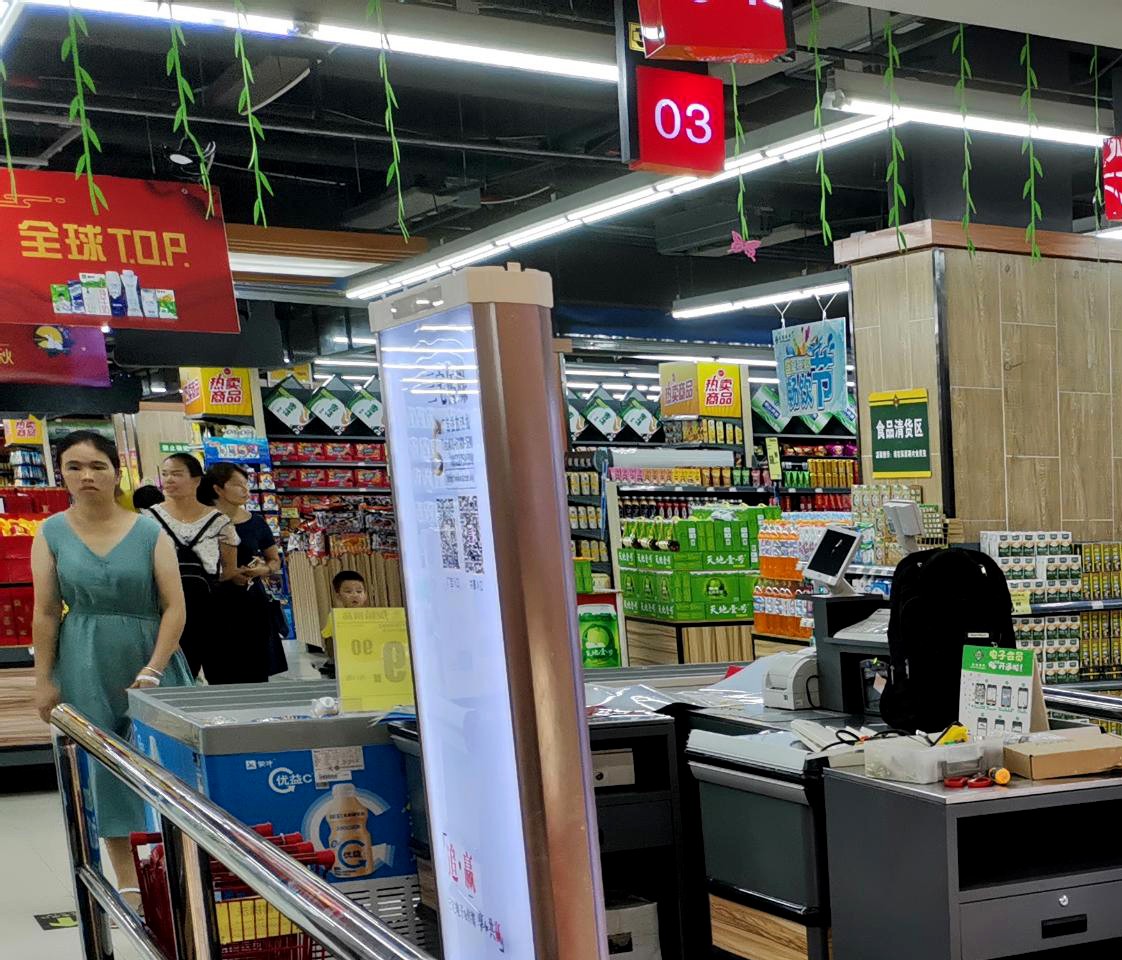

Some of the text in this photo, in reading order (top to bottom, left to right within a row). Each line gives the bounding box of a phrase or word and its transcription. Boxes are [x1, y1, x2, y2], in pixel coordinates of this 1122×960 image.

[655, 98, 712, 144] 03
[210, 390, 243, 405] 商品
[705, 391, 733, 406] 商品
[875, 417, 924, 440] 食品清货区
